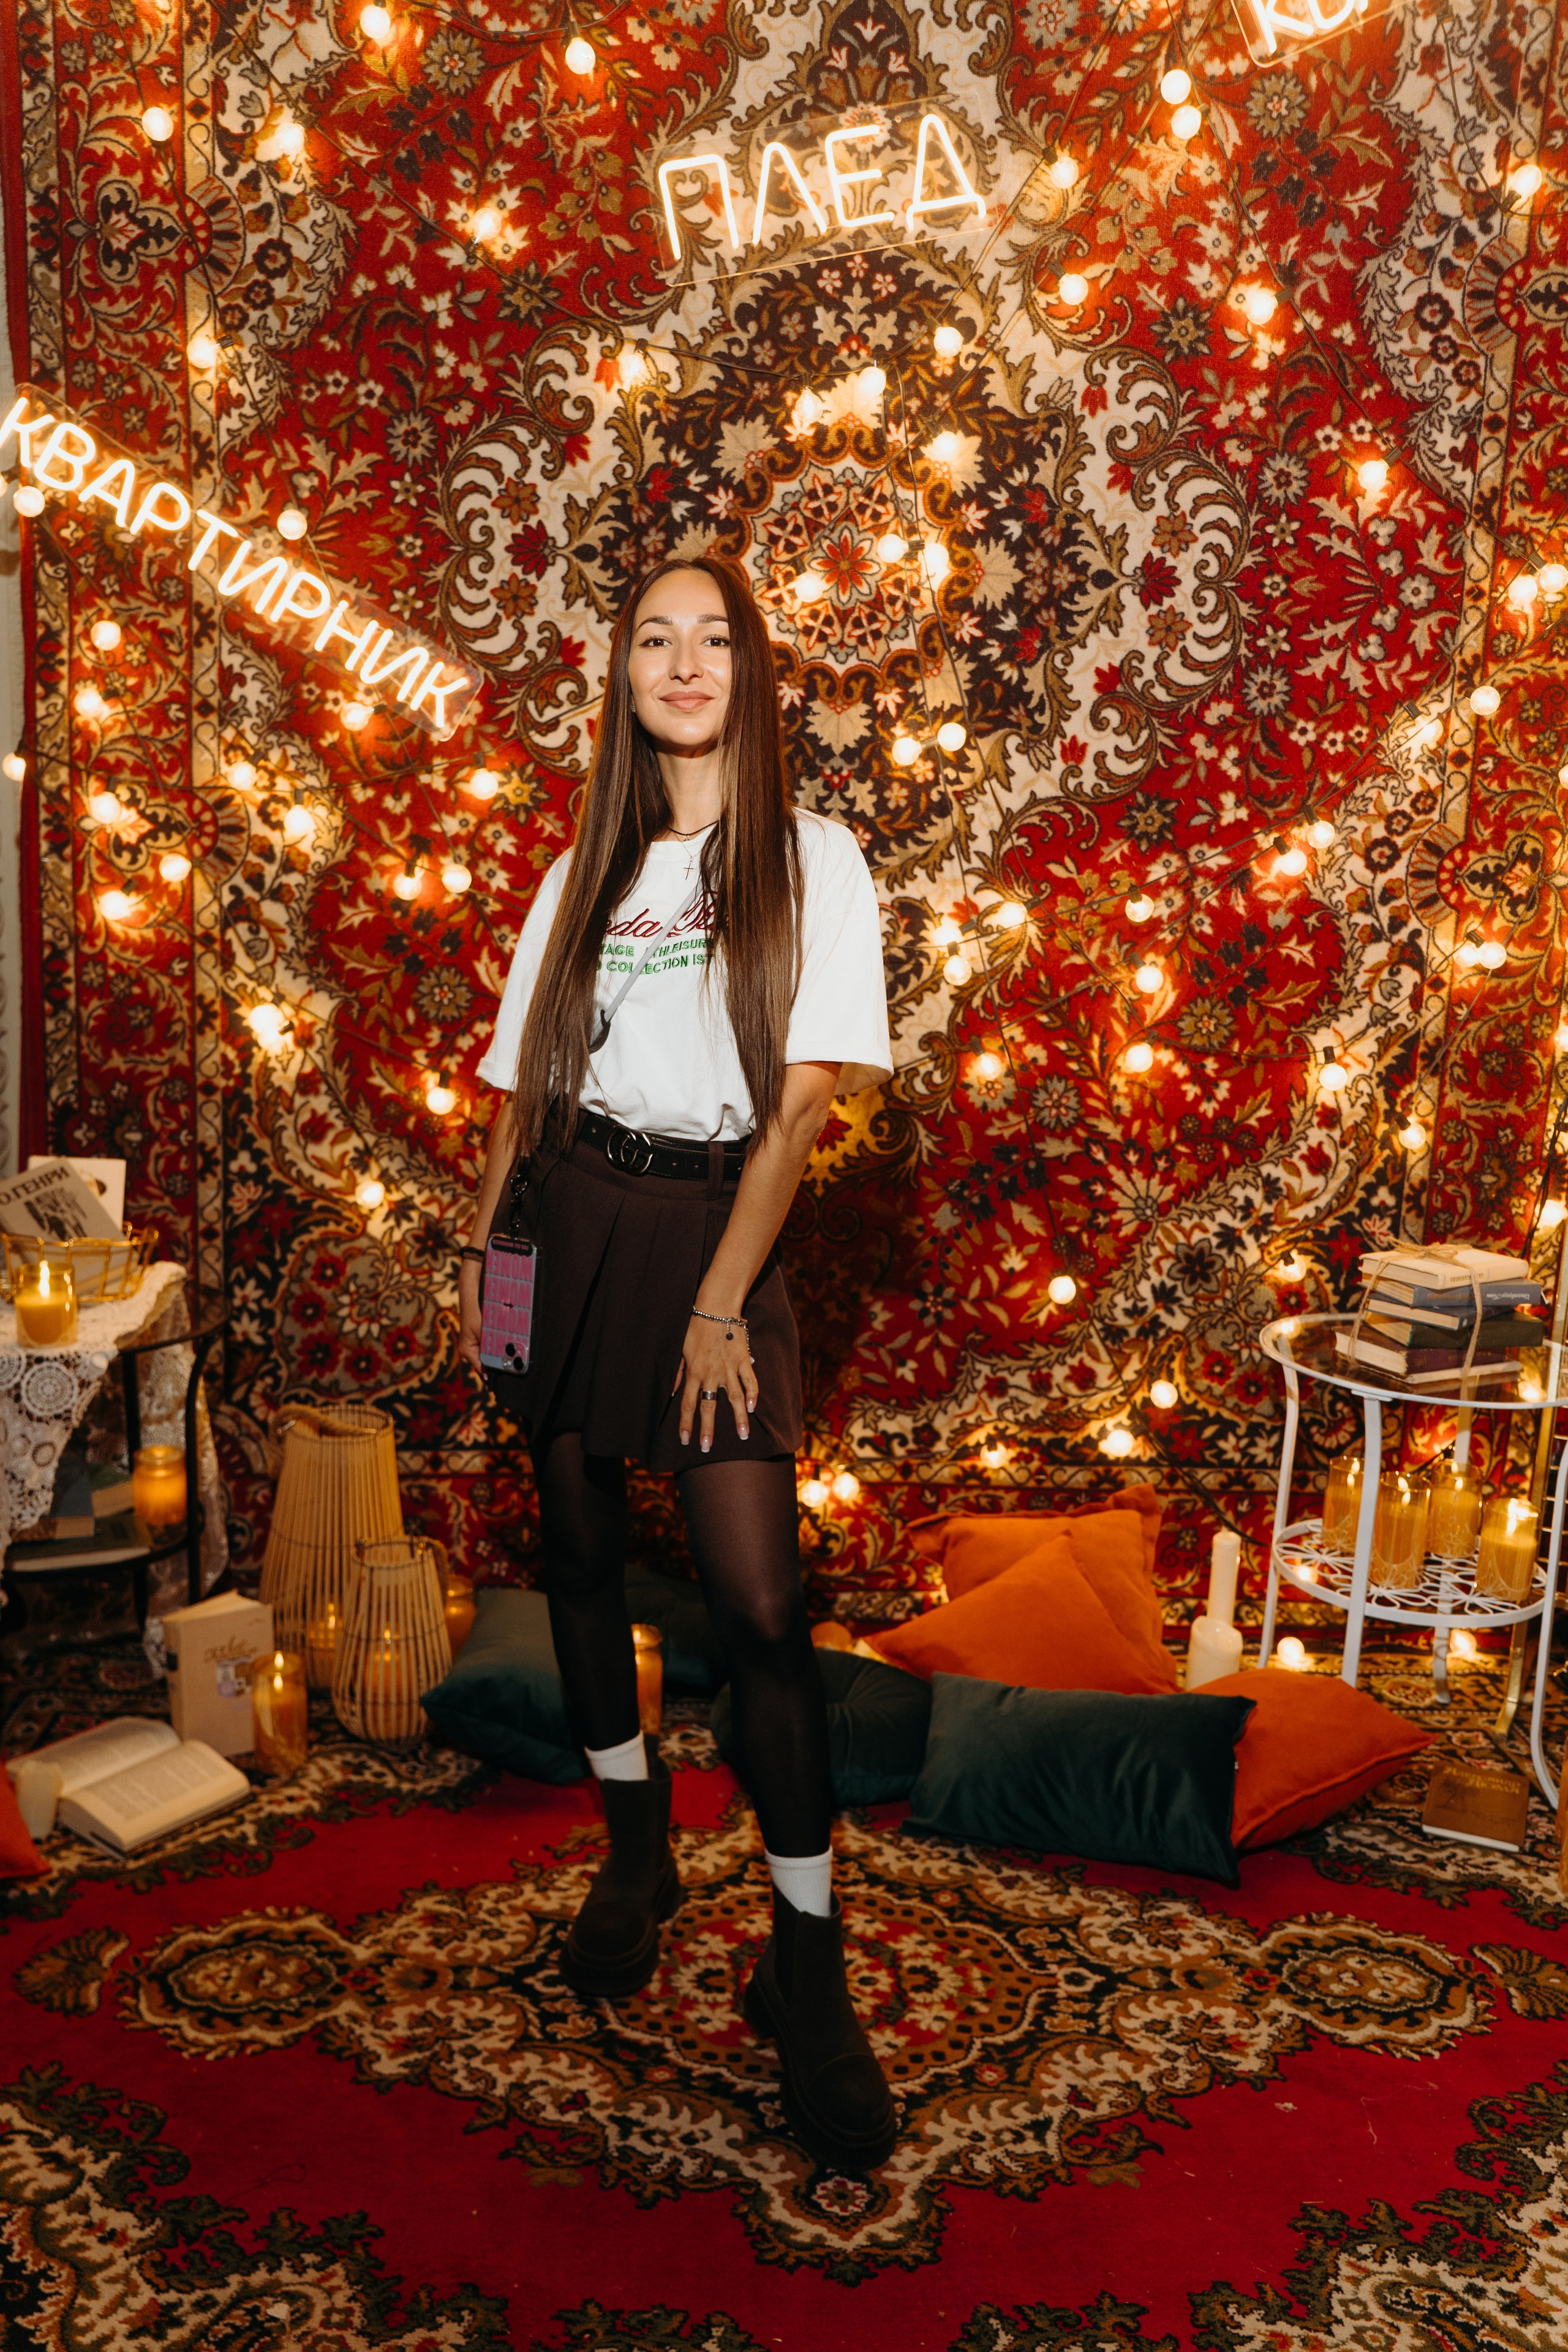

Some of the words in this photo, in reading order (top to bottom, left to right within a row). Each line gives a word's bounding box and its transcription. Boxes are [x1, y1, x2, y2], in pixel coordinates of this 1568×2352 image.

[658, 113, 986, 260] ПЛЕД
[0, 396, 469, 729] КВАРТИРНИК
[606, 955, 689, 975] COLECTION
